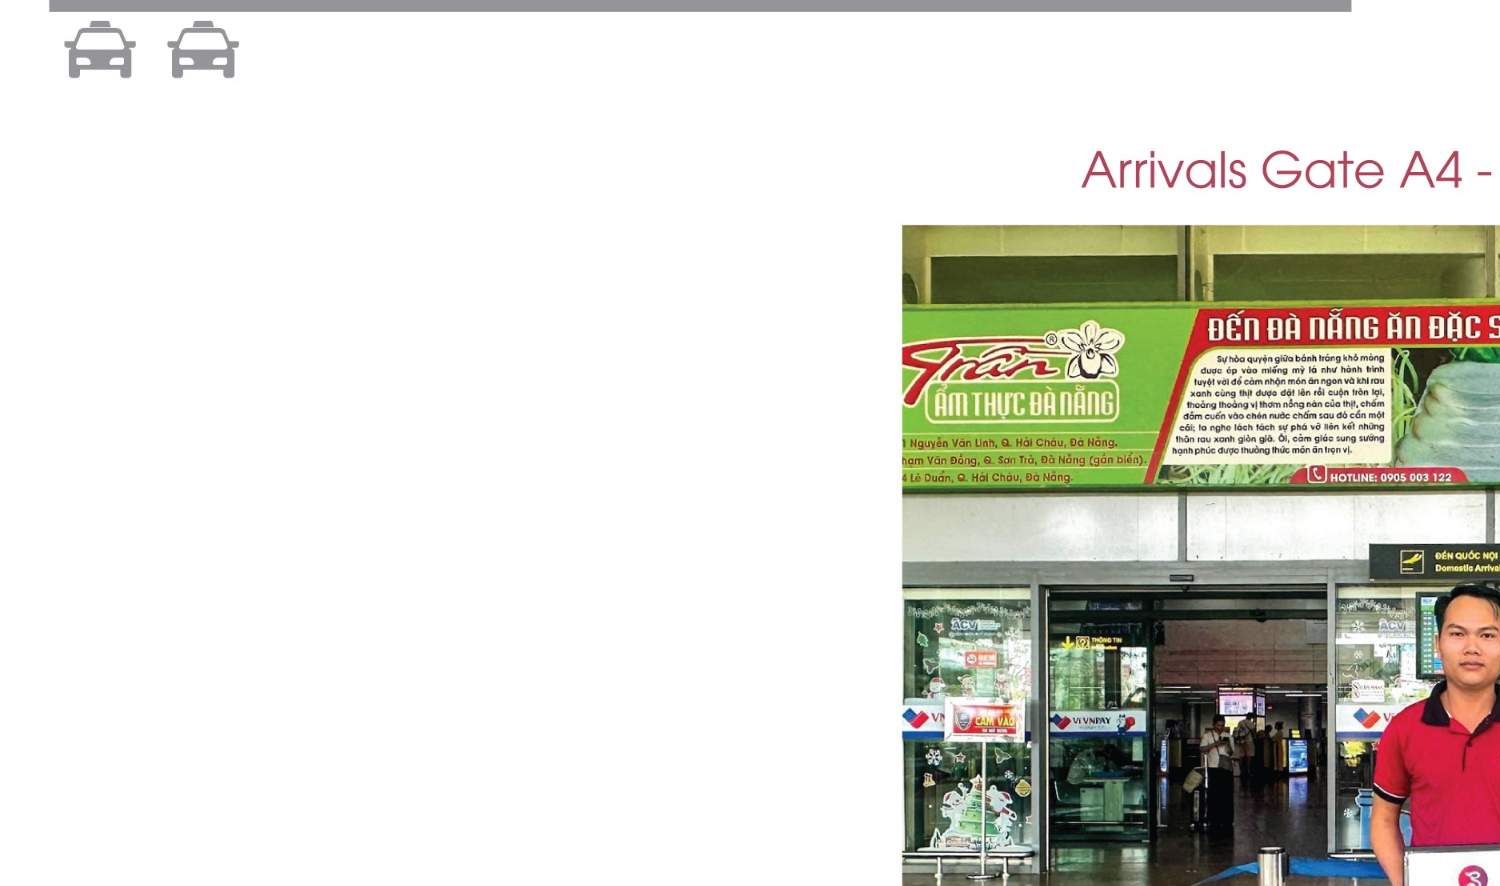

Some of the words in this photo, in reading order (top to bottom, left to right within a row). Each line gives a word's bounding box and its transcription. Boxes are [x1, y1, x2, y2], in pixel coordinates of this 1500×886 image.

[1208, 310, 1260, 341] ĐẾN
[1267, 312, 1300, 341] ĐÀ
[1309, 308, 1379, 340] NẴNG
[1387, 312, 1421, 339] ĂN
[1428, 311, 1481, 342] ĐẶC
[1321, 378, 1343, 387] ngon
[934, 384, 968, 417] ẨM
[973, 391, 1026, 420] THỰC
[1029, 387, 1056, 417] ĐÀ
[1060, 385, 1113, 416] NẴNG
[1336, 436, 1357, 444] sung
[1330, 473, 1378, 482] HOTLINE:
[1381, 473, 1407, 482] 0905
[1432, 473, 1452, 482] 122
[1435, 564, 1474, 572] Domestic
[952, 620, 977, 630] ACV
